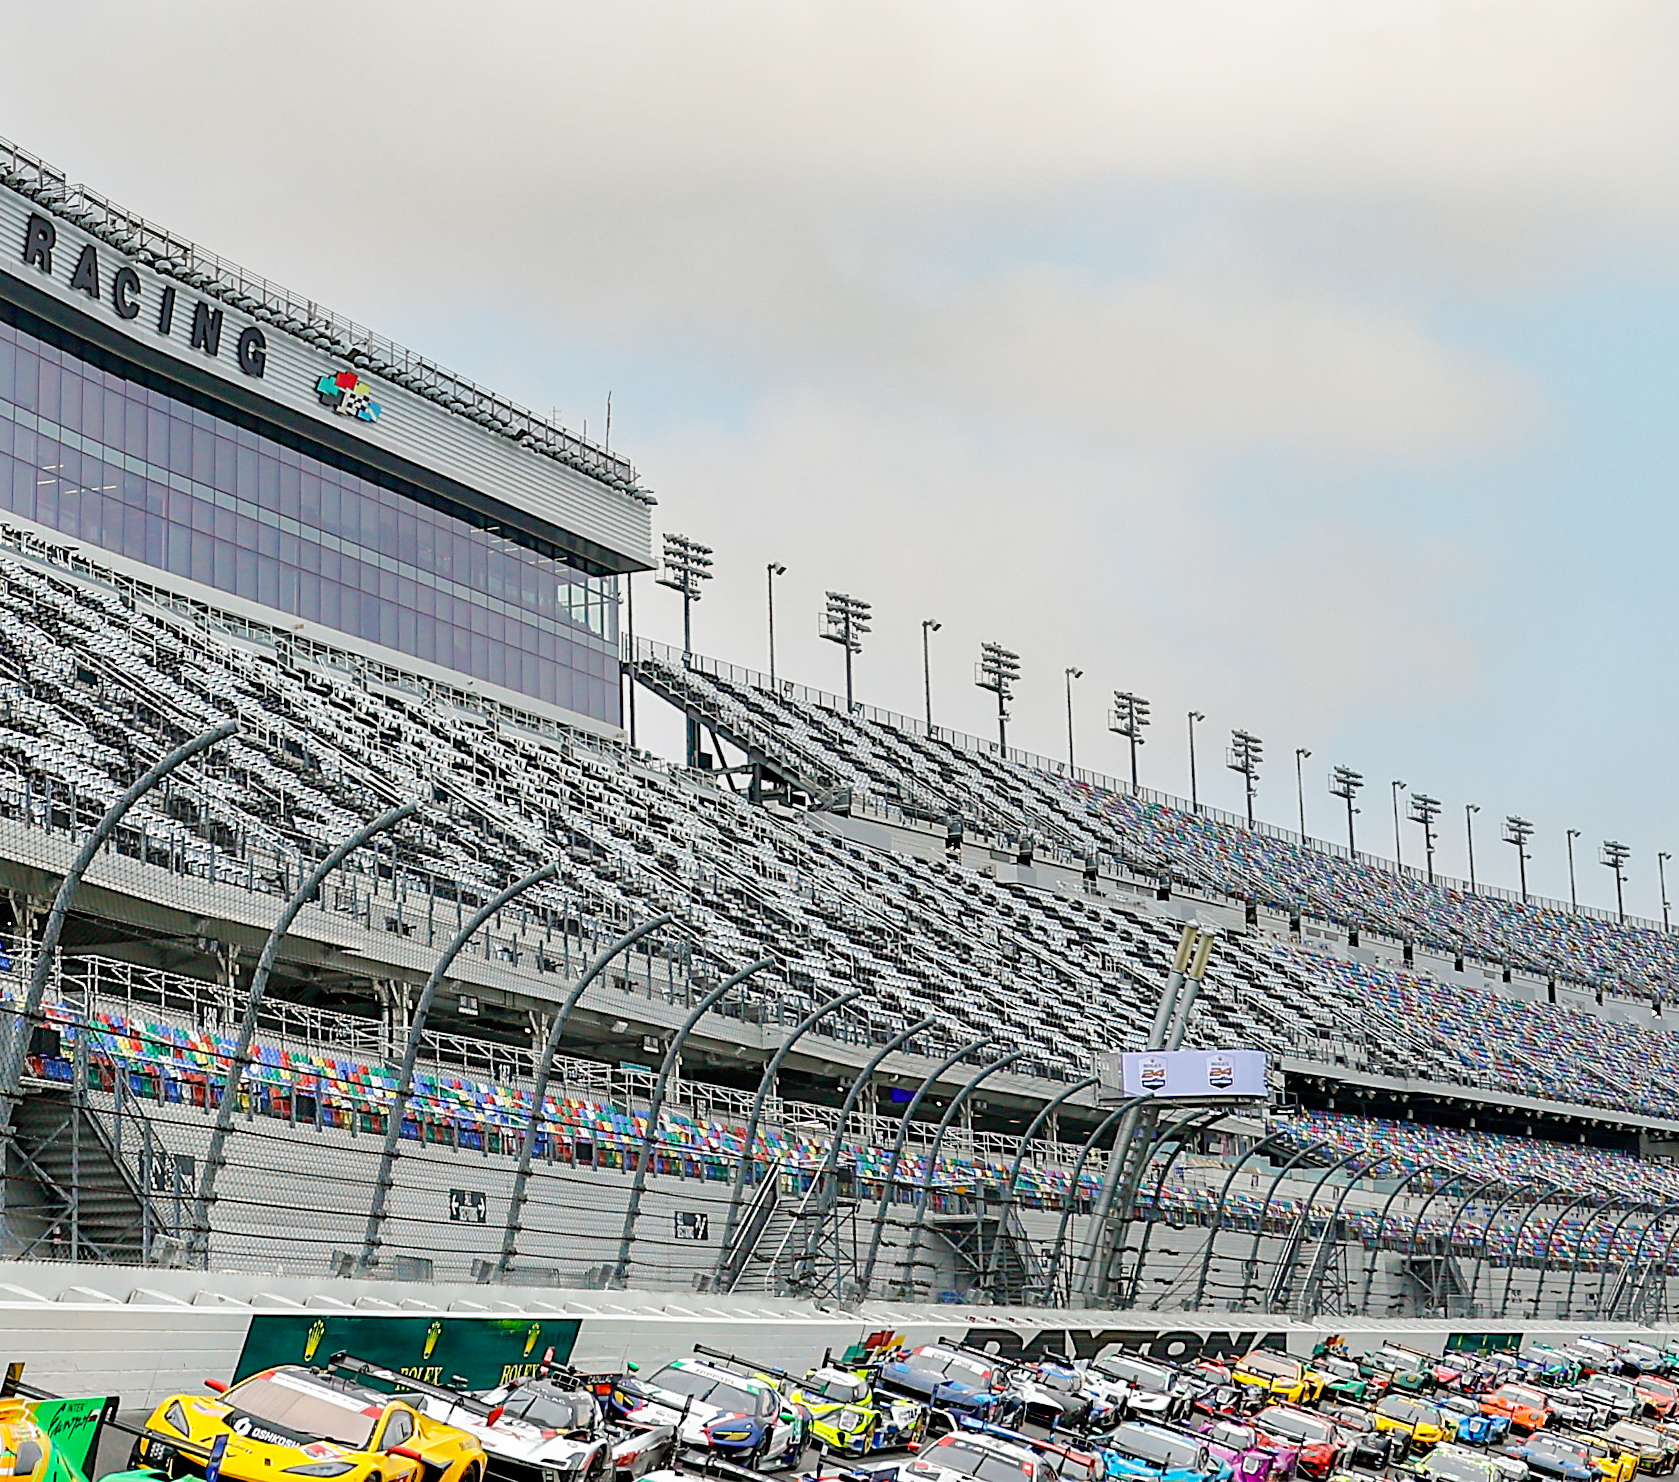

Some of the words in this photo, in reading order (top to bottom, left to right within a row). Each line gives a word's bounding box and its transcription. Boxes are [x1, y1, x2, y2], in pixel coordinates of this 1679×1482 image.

[24, 213, 267, 379] RACING
[1141, 1069, 1165, 1079] 24
[1209, 1067, 1233, 1077] 24
[965, 1327, 1290, 1365] DAYTONA
[500, 1364, 539, 1385] ROLEX
[251, 1427, 301, 1449] OSHKOSH
